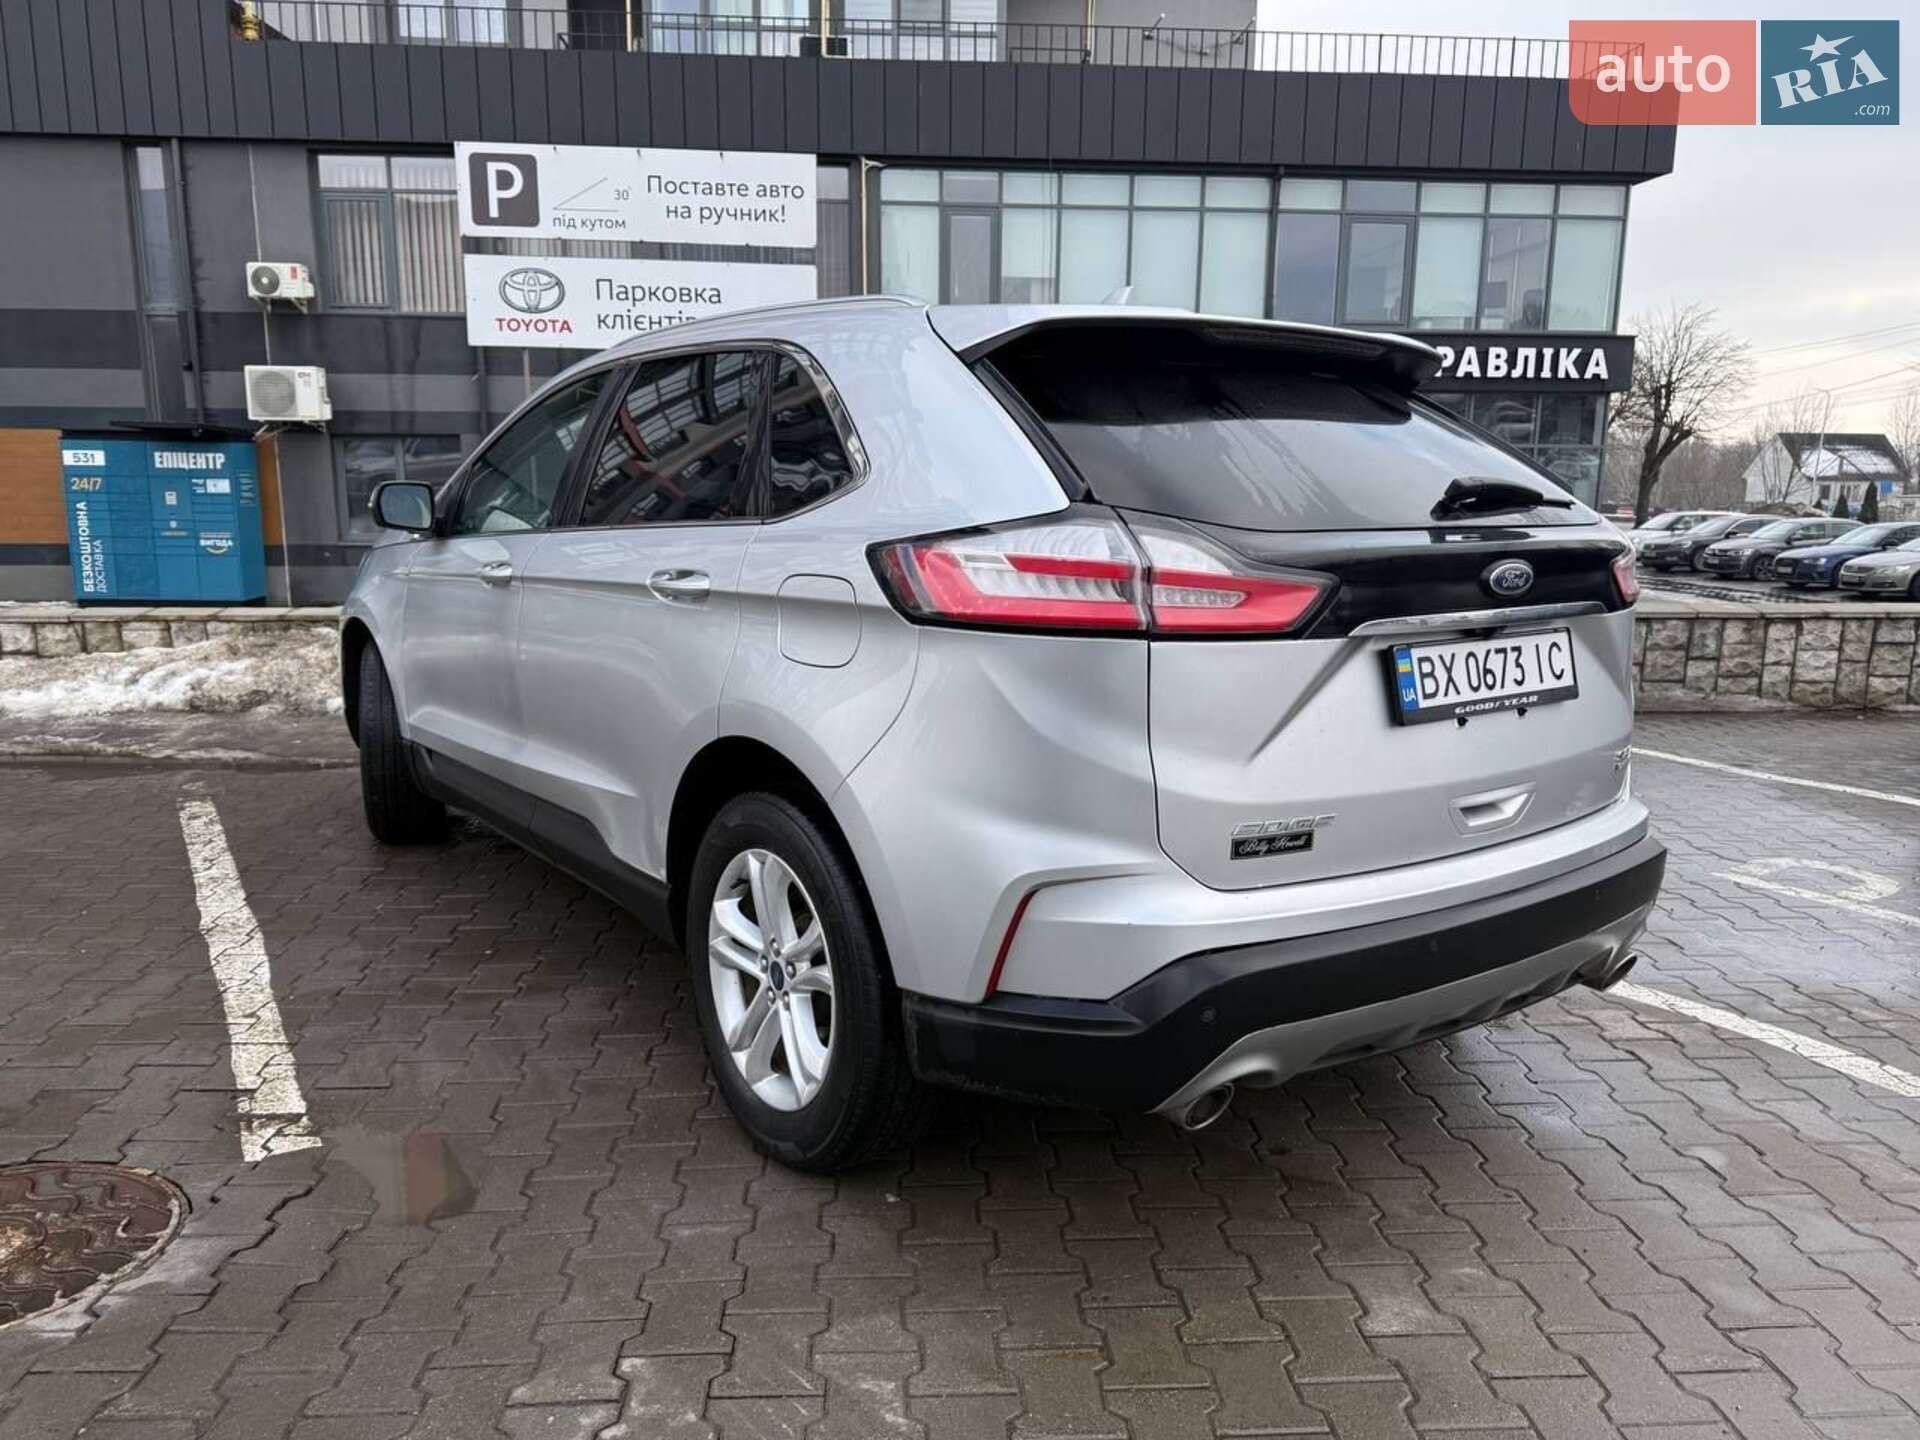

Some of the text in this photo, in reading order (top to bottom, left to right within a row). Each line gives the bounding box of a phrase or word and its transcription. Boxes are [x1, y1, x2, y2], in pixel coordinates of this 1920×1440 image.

[486, 161, 524, 218] P
[647, 175, 805, 200] Поставте авто
[552, 215, 627, 230] під кутом
[666, 205, 786, 225] на ручник!
[596, 278, 722, 306] Парковка
[495, 318, 573, 335] TOYOTA
[72, 452, 96, 464] 531
[154, 451, 226, 471] ЕПІЦЕНТР
[70, 477, 102, 492] 24/7
[75, 501, 95, 593] БЕЗКОШТОВНА
[1417, 641, 1565, 700] BX 0673 IC
[1402, 689, 1416, 702] UA
